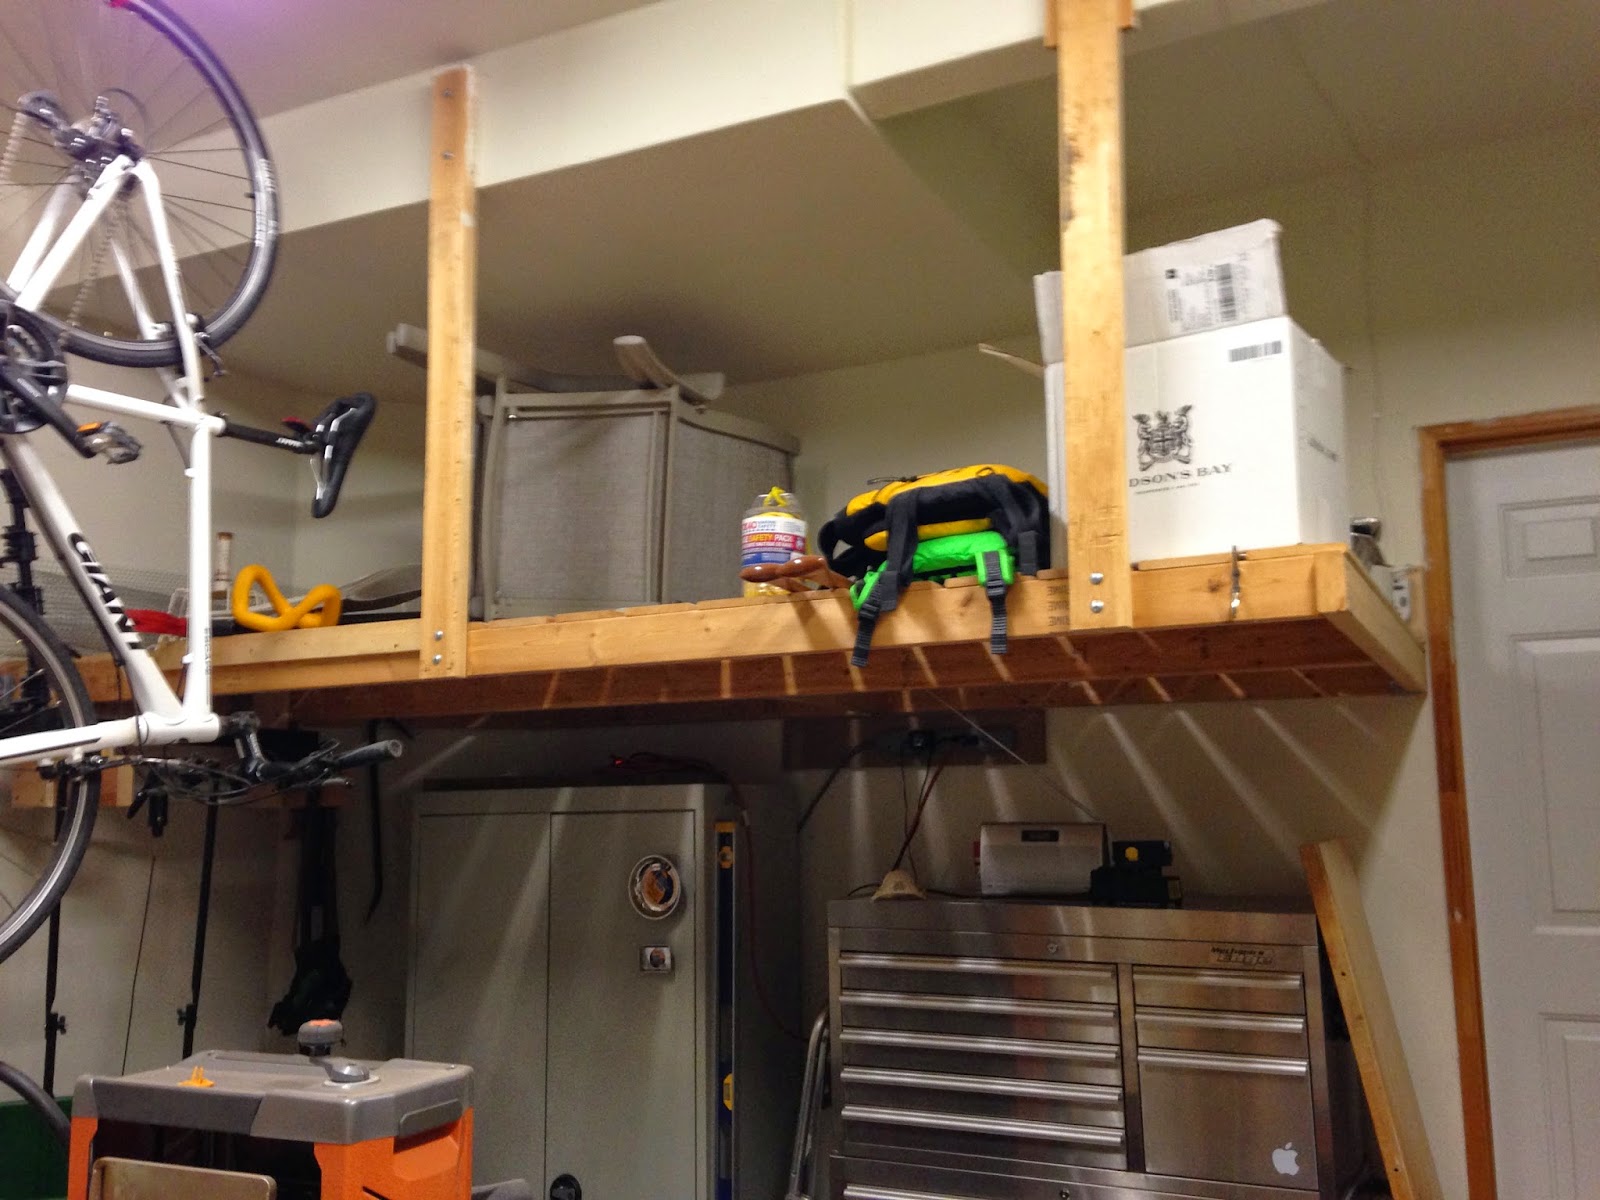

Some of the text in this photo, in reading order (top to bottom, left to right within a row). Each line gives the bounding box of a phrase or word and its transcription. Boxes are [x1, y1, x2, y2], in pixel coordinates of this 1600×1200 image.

[1197, 463, 1232, 477] BAY
[748, 534, 773, 543] SAFETY
[774, 534, 793, 543] PACK
[68, 532, 141, 649] GIANT
